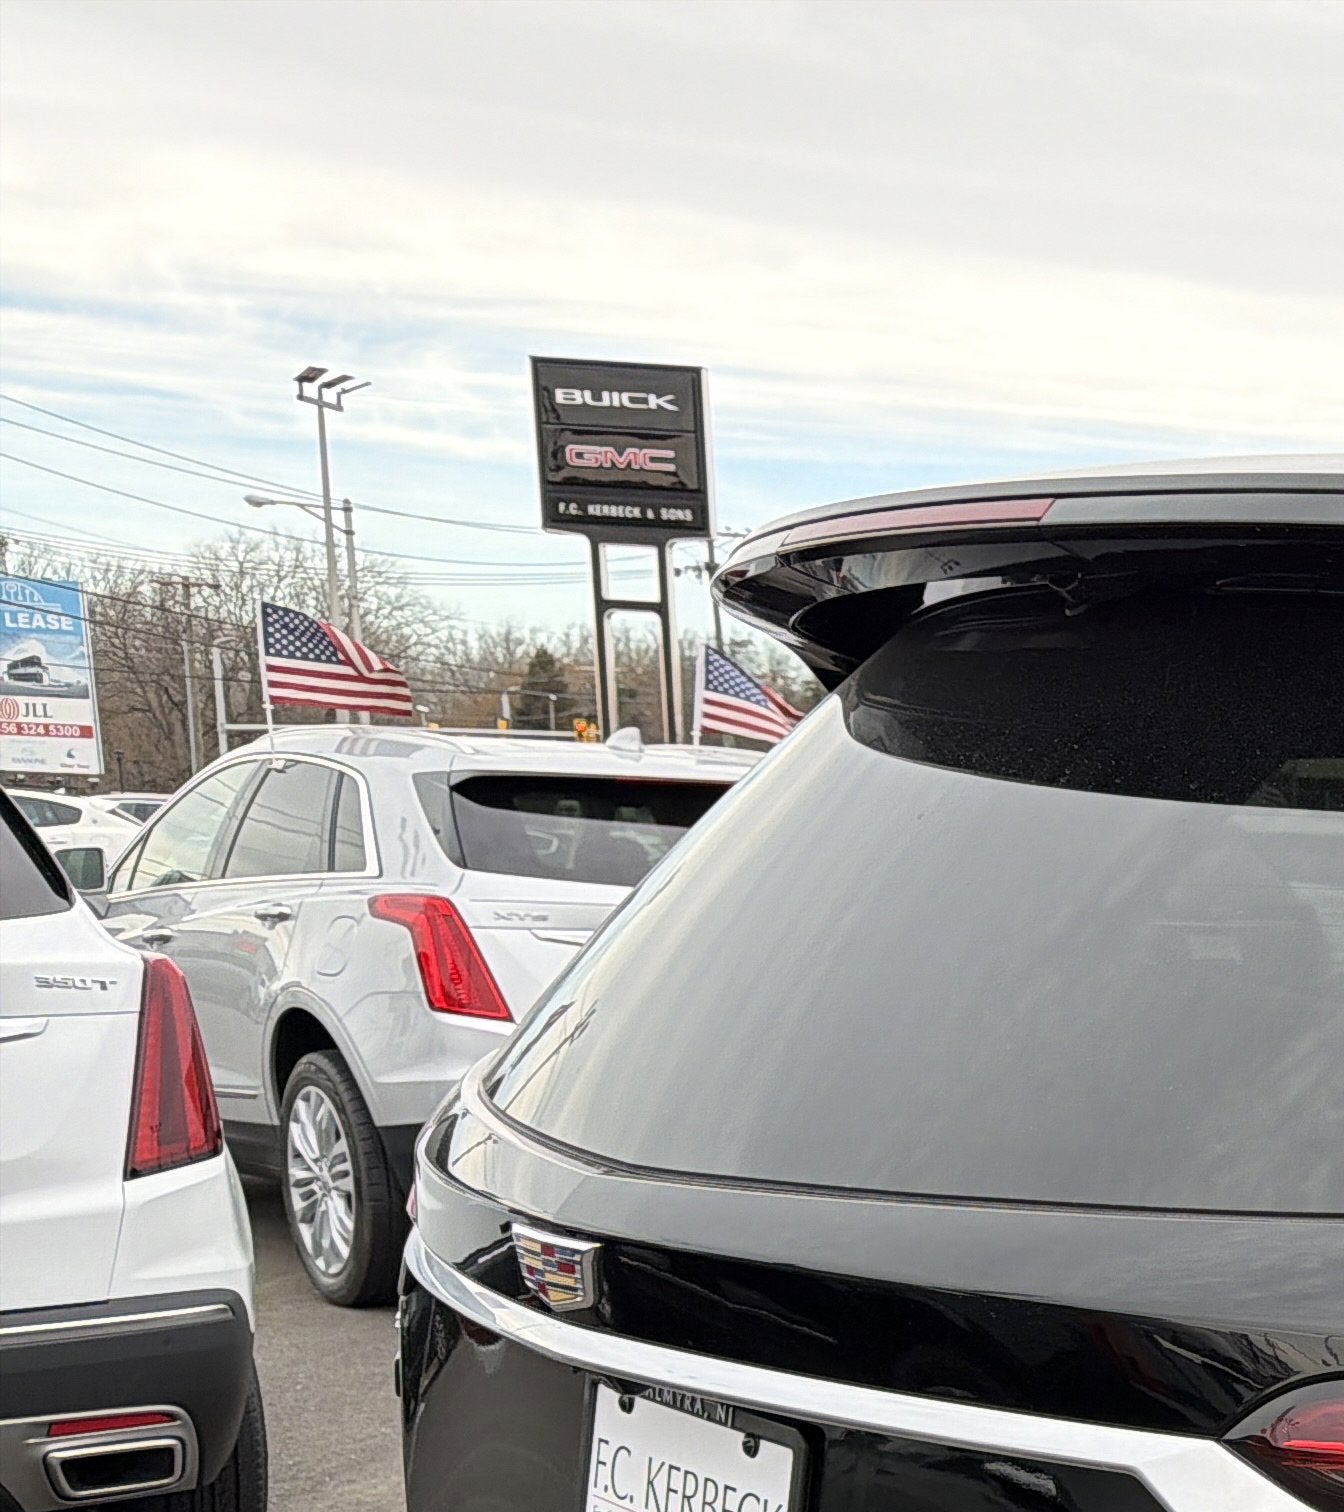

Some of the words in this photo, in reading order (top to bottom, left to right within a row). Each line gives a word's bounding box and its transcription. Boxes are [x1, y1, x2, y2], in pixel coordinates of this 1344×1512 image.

[554, 387, 679, 412] BUICK
[564, 444, 677, 472] GMC
[559, 502, 584, 516] F.C.
[587, 504, 642, 519] KERBECK
[660, 507, 694, 521] SONS
[4, 611, 75, 631] LEASE
[21, 702, 54, 719] JLL
[0, 722, 17, 734] 56
[20, 723, 46, 735] 324
[48, 724, 81, 737] 5300
[34, 975, 118, 991] 350T
[593, 1437, 634, 1505] F.C.
